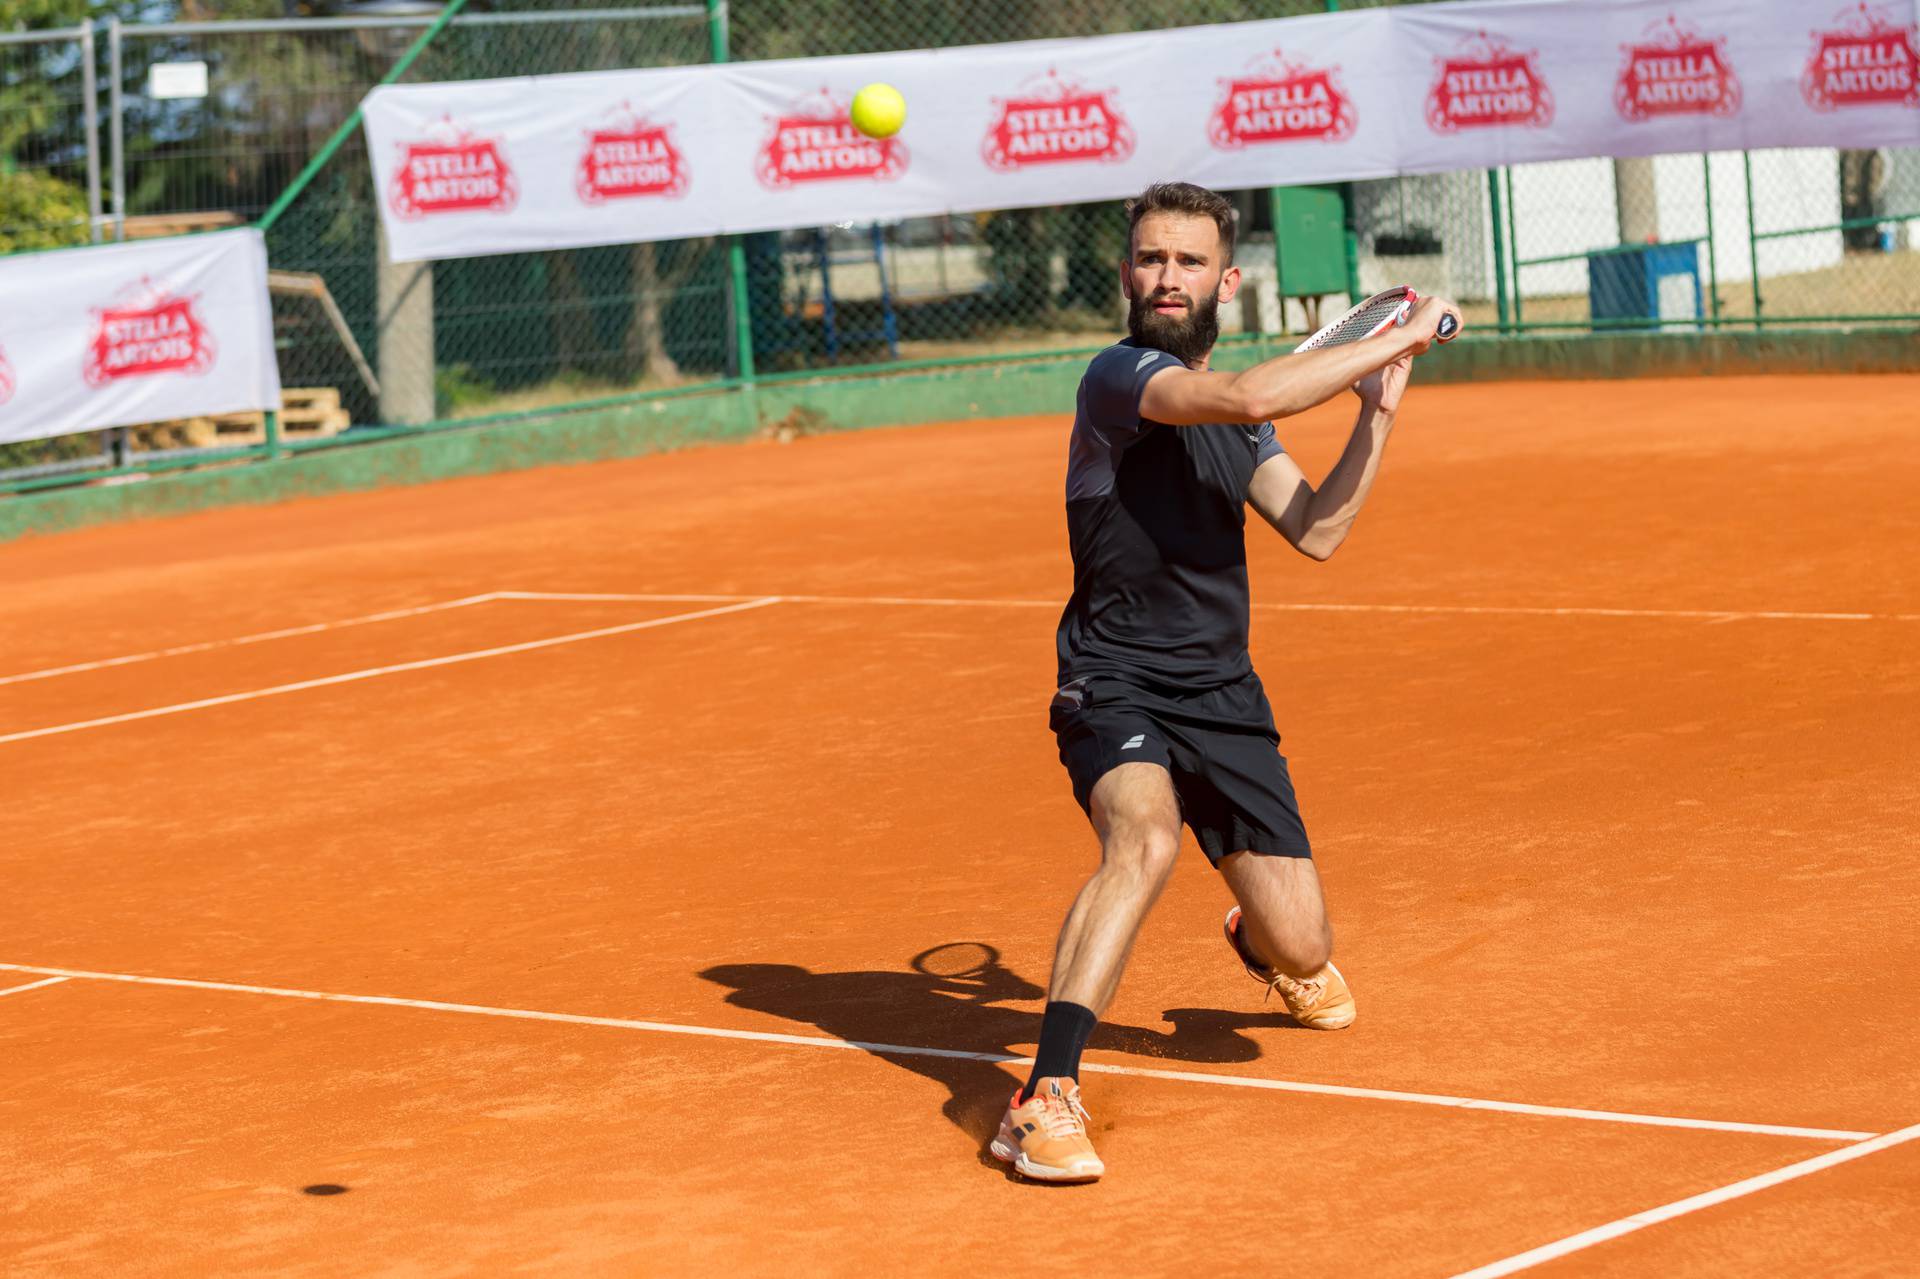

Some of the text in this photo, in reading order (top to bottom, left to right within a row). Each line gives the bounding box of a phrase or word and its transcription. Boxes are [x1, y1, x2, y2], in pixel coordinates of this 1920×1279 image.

[1635, 57, 1715, 79] STELLA
[1823, 43, 1908, 69] STELLA
[1447, 68, 1529, 92] STELLA
[1637, 78, 1719, 101] ARTOIS
[1824, 68, 1911, 92] ARTOIS
[1233, 83, 1330, 111] STELLA
[1448, 93, 1532, 115] ARTOIS
[1007, 105, 1106, 132] STELLA
[1234, 107, 1333, 132] ARTOIS
[595, 139, 668, 163] STELLA
[1008, 129, 1109, 154] ARTOIS
[411, 153, 496, 178] STELLA
[781, 147, 883, 172] ARTOIS
[597, 164, 671, 185] ARTOIS
[415, 177, 499, 201] ARTOIS
[105, 314, 190, 344] STELLA
[107, 339, 192, 367] ARTOIS
